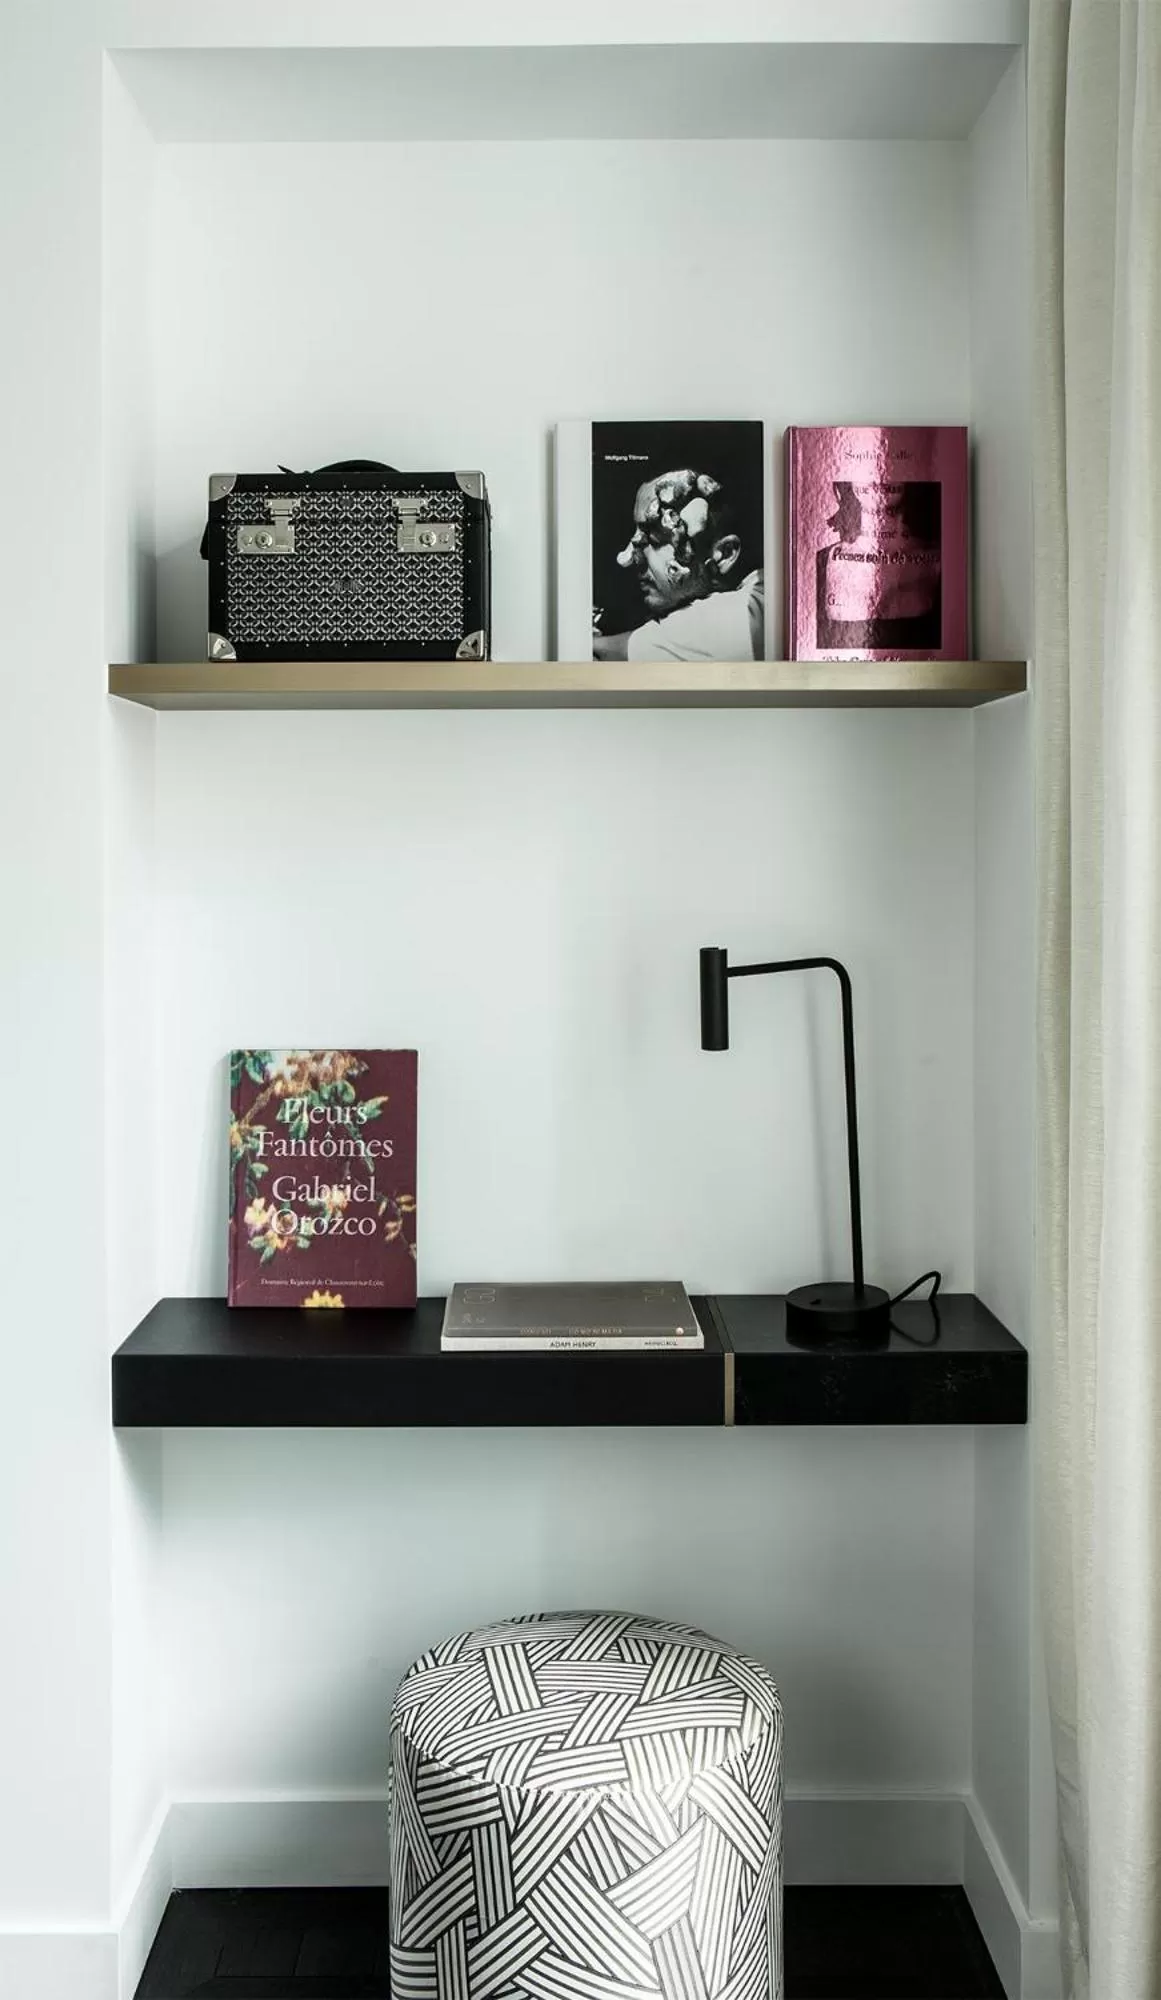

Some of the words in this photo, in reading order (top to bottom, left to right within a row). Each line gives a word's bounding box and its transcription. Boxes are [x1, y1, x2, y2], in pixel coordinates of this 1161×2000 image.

[604, 454, 628, 462] Wolfgang
[282, 1096, 369, 1125] Fleurs
[255, 1130, 394, 1158] Fantômes
[271, 1174, 377, 1203] Gabriel
[271, 1207, 377, 1236] Orozco
[550, 1341, 571, 1349] ADAM
[572, 1341, 597, 1349] HENRY
